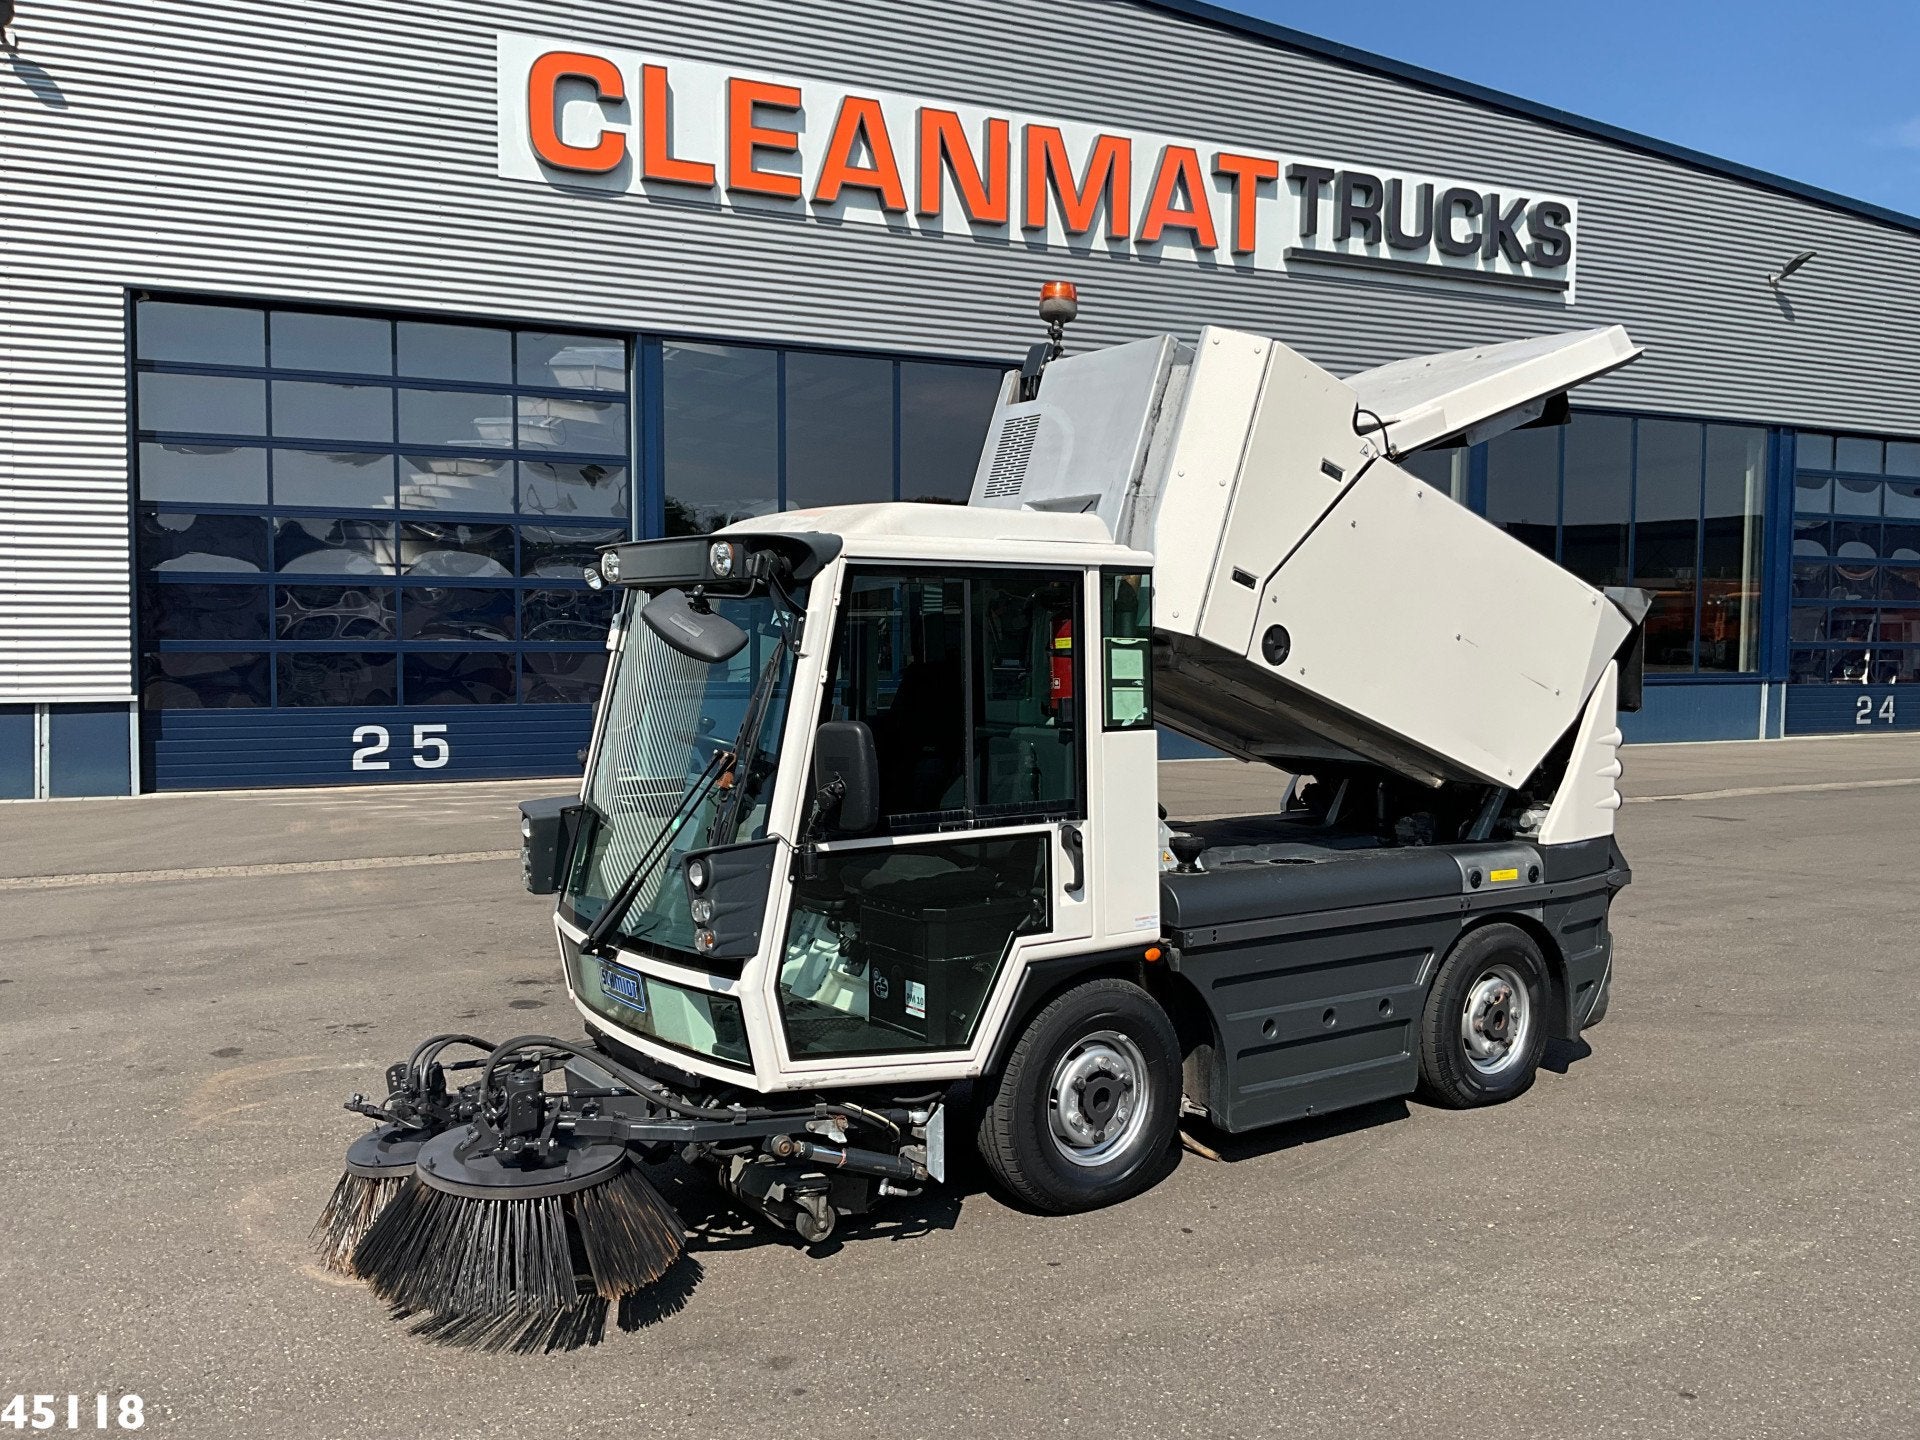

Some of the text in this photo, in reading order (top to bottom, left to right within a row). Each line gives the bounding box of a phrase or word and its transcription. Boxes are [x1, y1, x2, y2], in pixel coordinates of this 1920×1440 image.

[528, 51, 1571, 267] CLEANMAT TRUCKS
[1856, 695, 1895, 725] 24
[352, 724, 449, 770] 25
